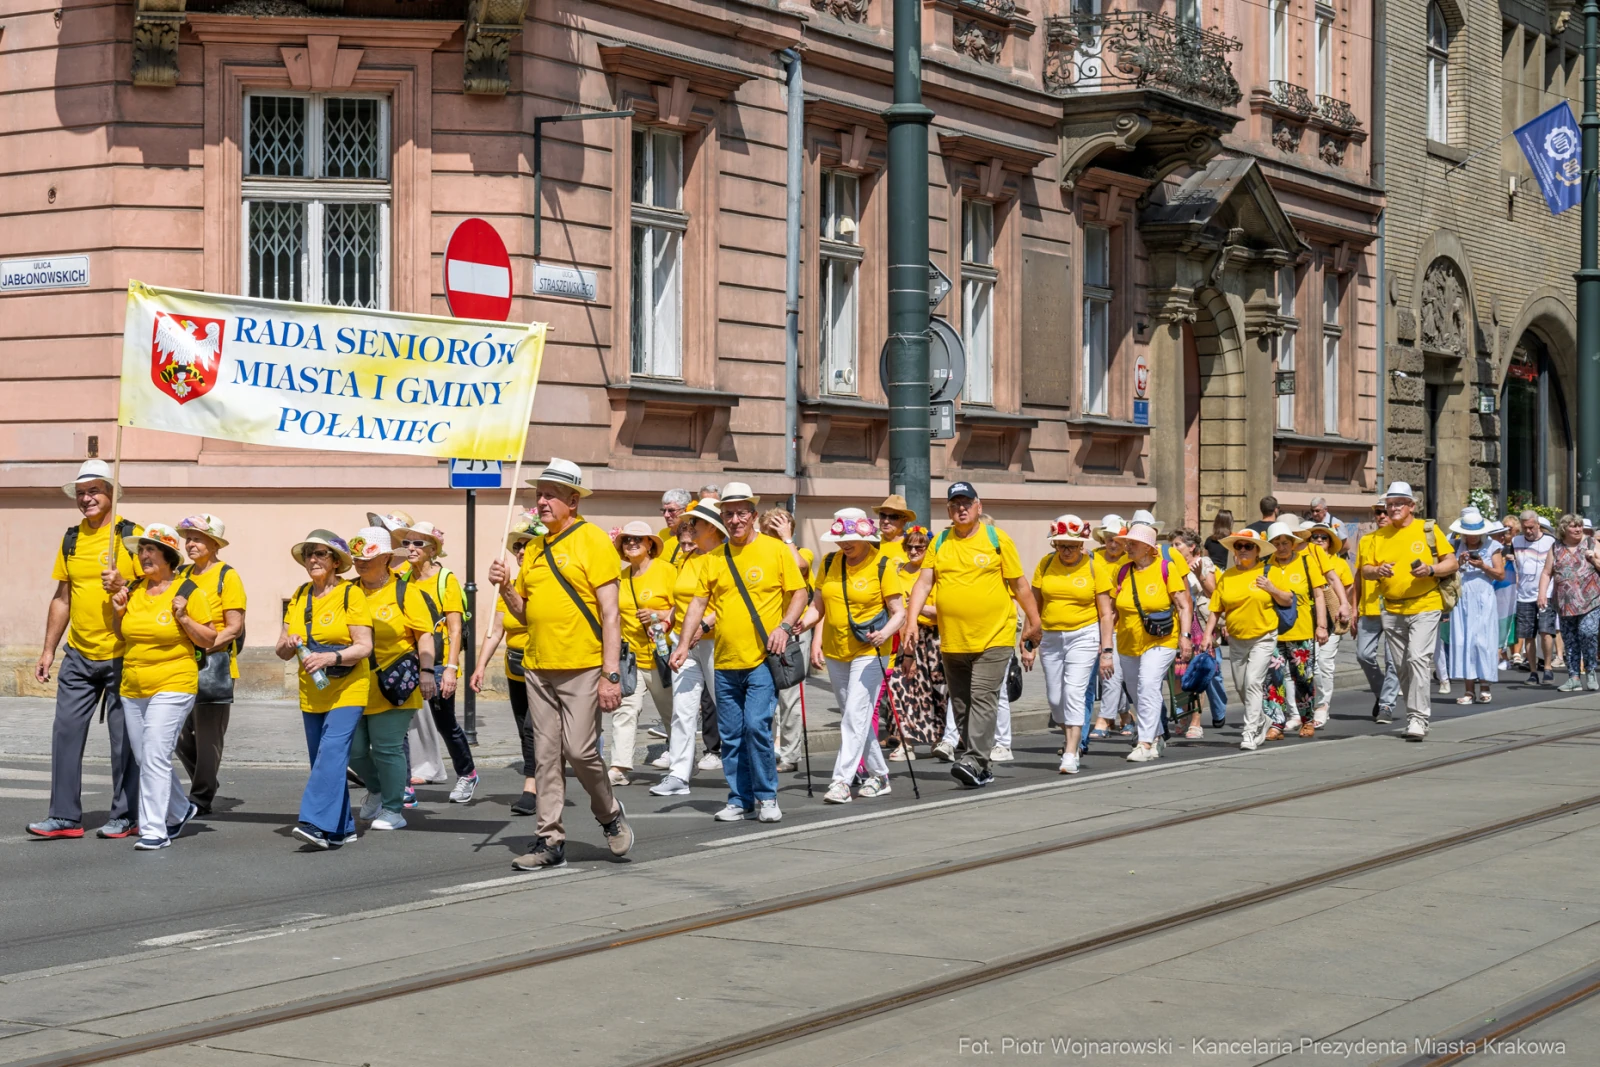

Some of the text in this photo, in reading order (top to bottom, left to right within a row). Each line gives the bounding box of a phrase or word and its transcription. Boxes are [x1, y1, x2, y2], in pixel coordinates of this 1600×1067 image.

[1552, 132, 1570, 153] NOT
[2, 269, 86, 286] JABŁONOWSKICH
[232, 316, 523, 367] RADA SENIORÓW
[230, 359, 513, 408] MIASTA I GMINY
[274, 406, 451, 445] POŁANIEC
